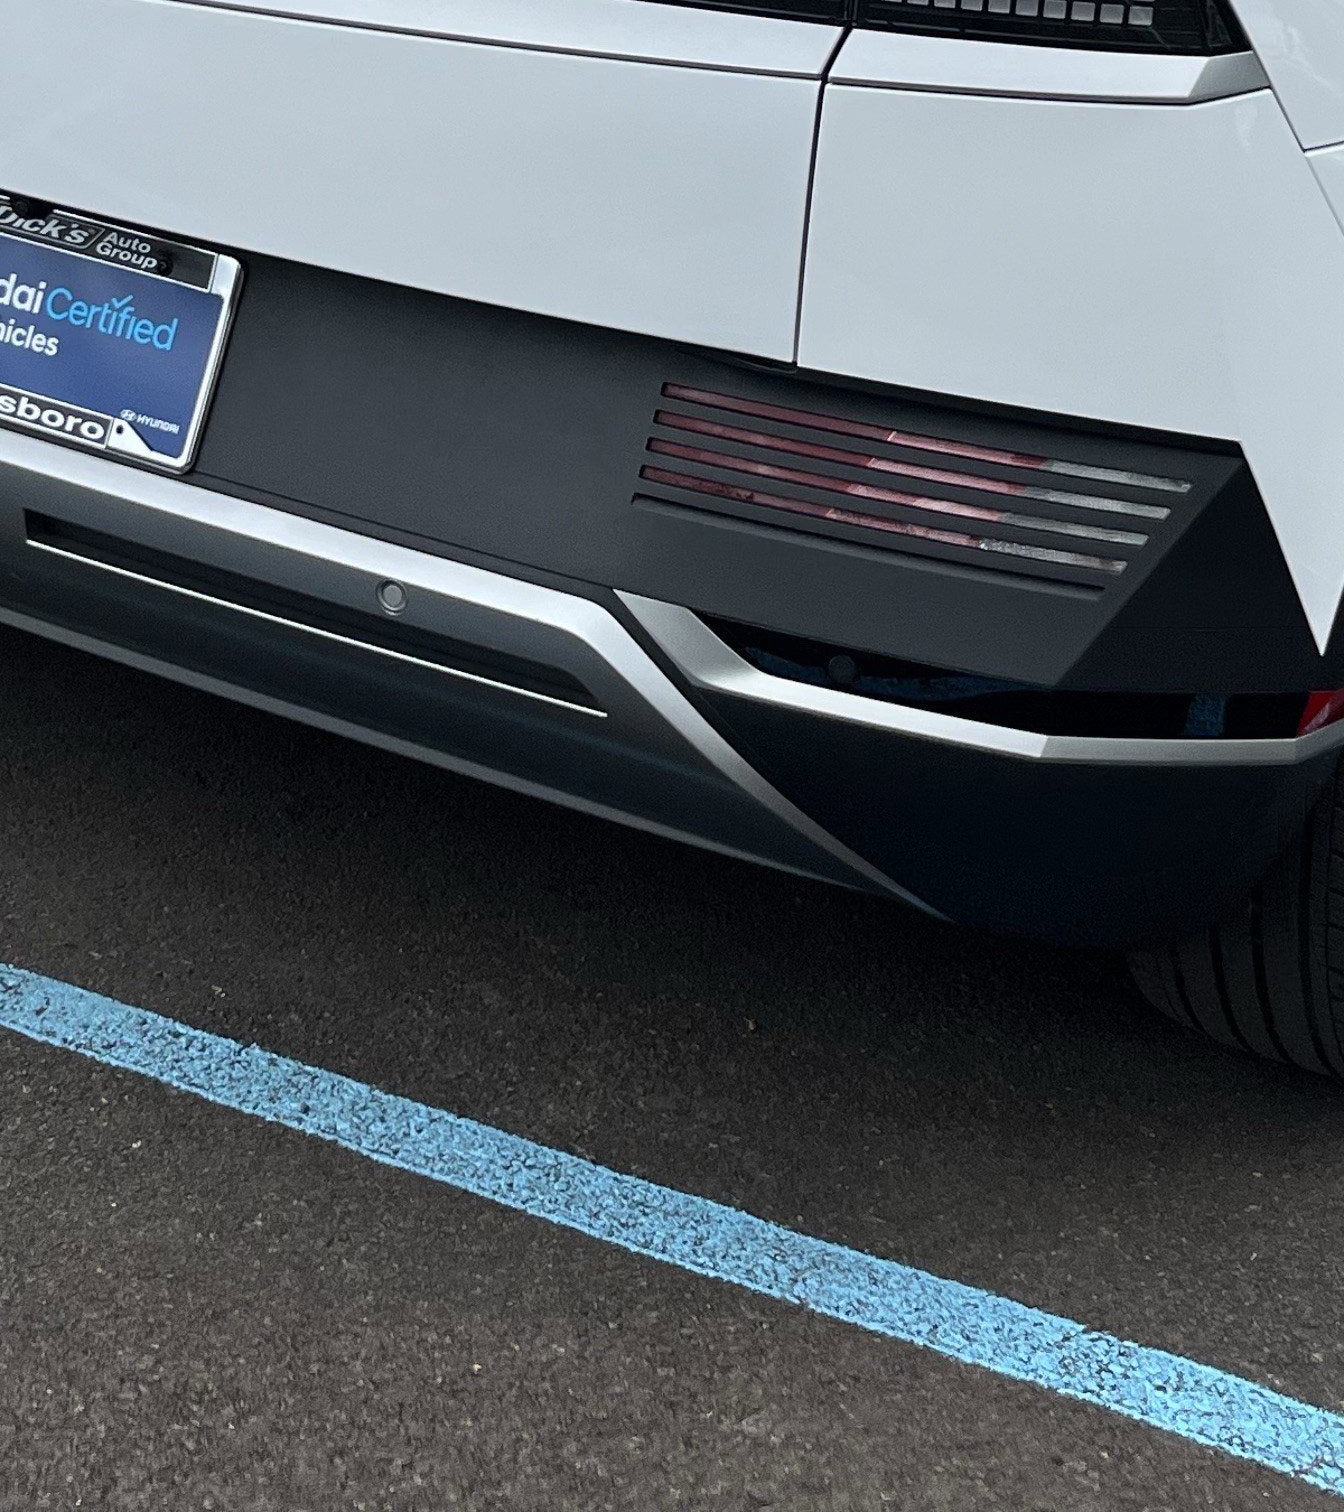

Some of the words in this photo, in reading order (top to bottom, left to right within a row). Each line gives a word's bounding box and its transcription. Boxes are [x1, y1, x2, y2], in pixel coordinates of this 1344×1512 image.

[102, 231, 152, 254] Auto
[95, 243, 158, 270] Group
[46, 288, 179, 351] Certified
[136, 414, 181, 435] HYUNDAI
